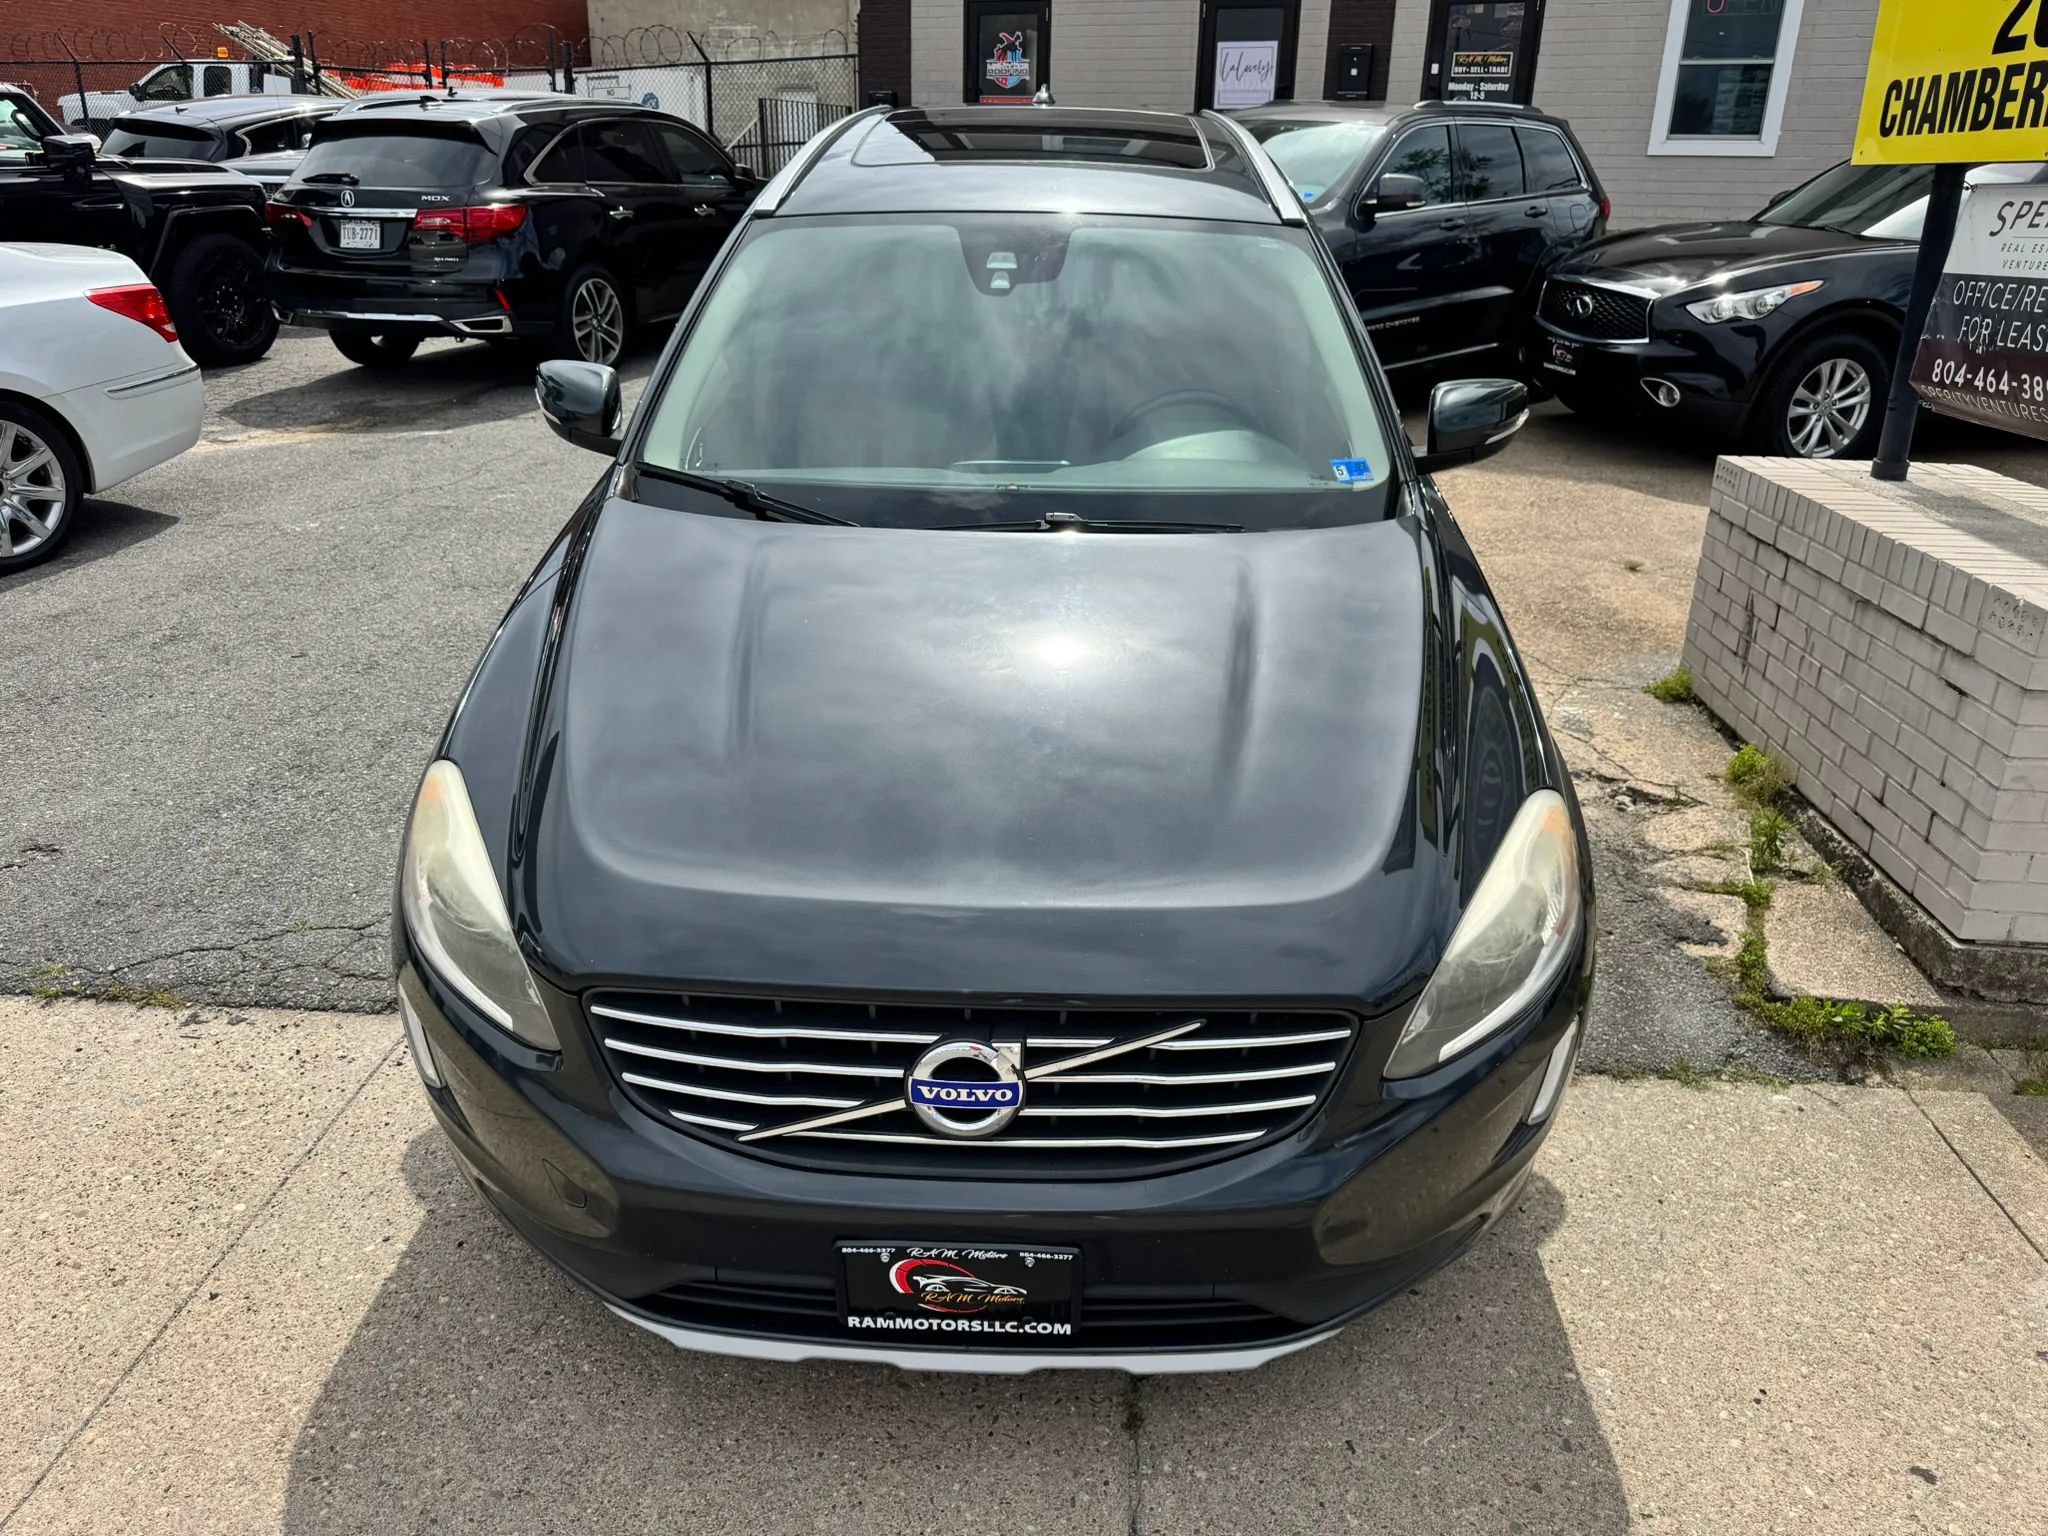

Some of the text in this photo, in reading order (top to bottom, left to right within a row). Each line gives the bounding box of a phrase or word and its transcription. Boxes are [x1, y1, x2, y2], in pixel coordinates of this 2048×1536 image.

[1447, 82, 1474, 92] Monday
[1480, 82, 1509, 92] Saturday
[1880, 60, 2048, 138] CHAMBER
[1988, 200, 2048, 237] SPE
[2001, 242, 2025, 253] REAL
[1953, 280, 2048, 313] OFFICE/RE
[1958, 315, 2048, 353] FOR LEAS
[1931, 358, 2048, 402] 804-464-38
[917, 1085, 1013, 1102] VOLVO
[906, 1247, 1008, 1260] RAM Motors
[920, 1290, 1026, 1305] RAM Motors
[847, 1316, 1072, 1335] RAMMOTORSLLC.COM
